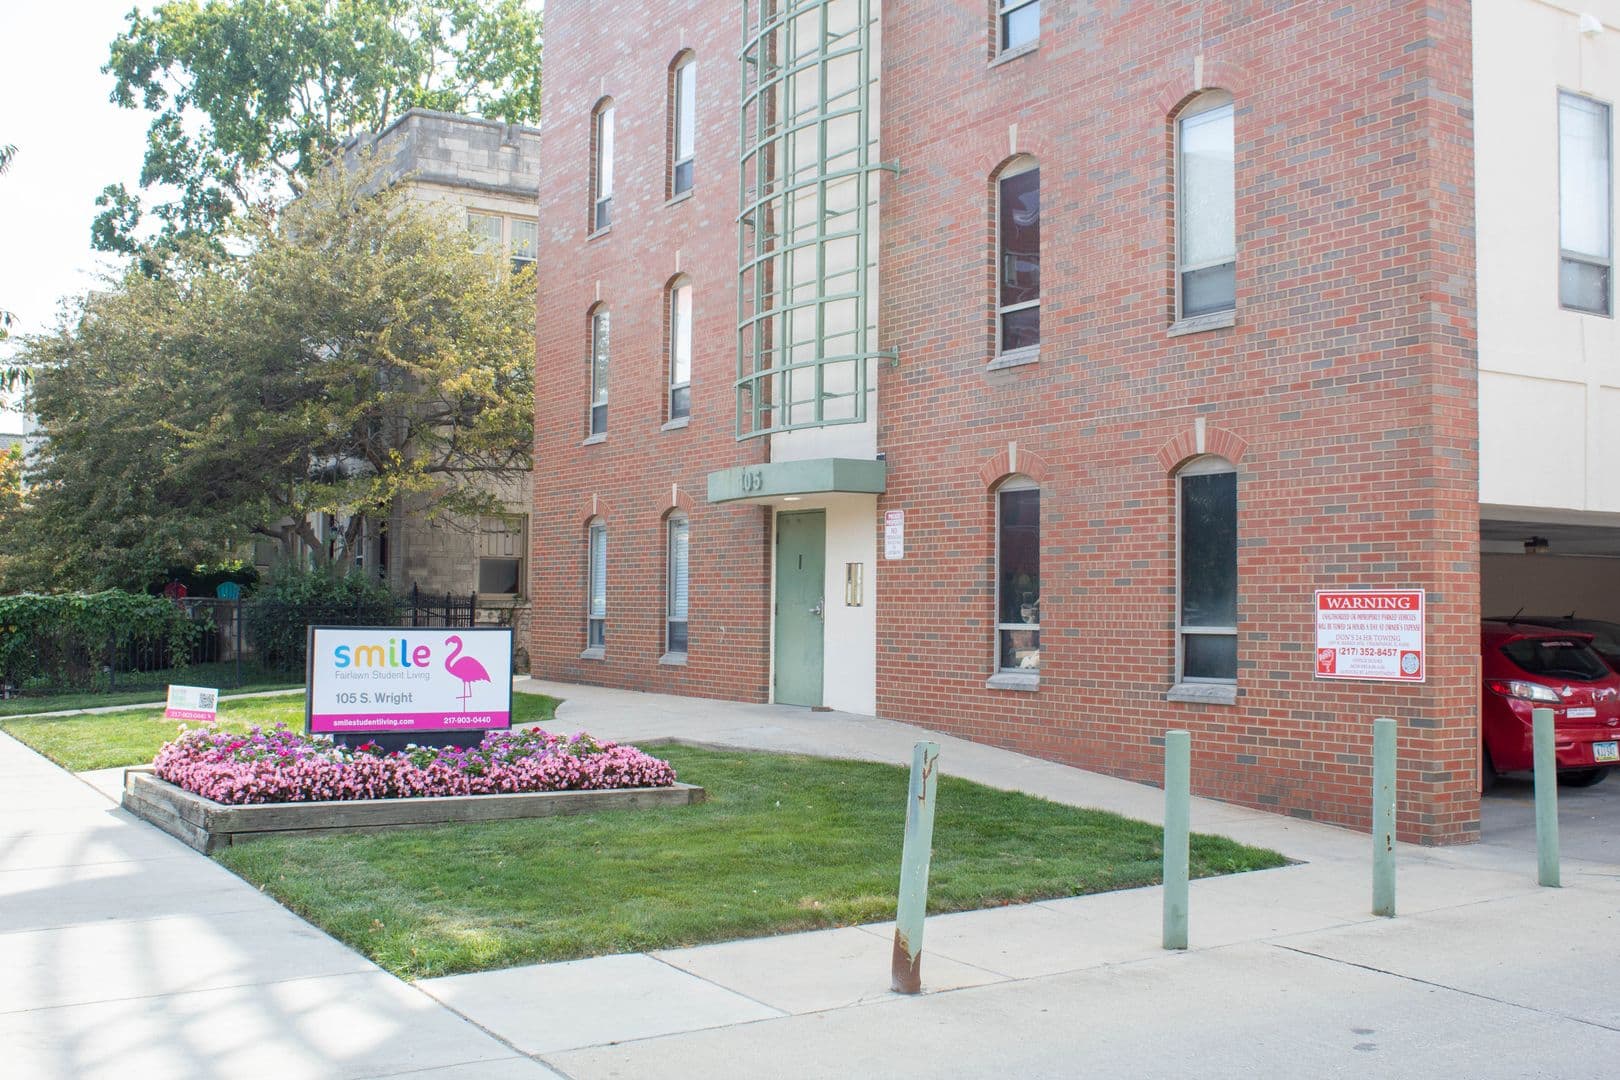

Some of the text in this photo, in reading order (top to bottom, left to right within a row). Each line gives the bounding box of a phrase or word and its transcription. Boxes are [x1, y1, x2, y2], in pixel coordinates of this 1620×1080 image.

[1326, 597, 1411, 609] WARNING
[333, 638, 431, 668] smile
[1339, 647, 1358, 656] (217)
[1360, 648, 1397, 656] 352-8457
[335, 671, 430, 681] Fairlawn Student Living
[336, 692, 413, 705] 105 S. Wright
[333, 716, 491, 727] smilestudentliving.com 217-903-0440
